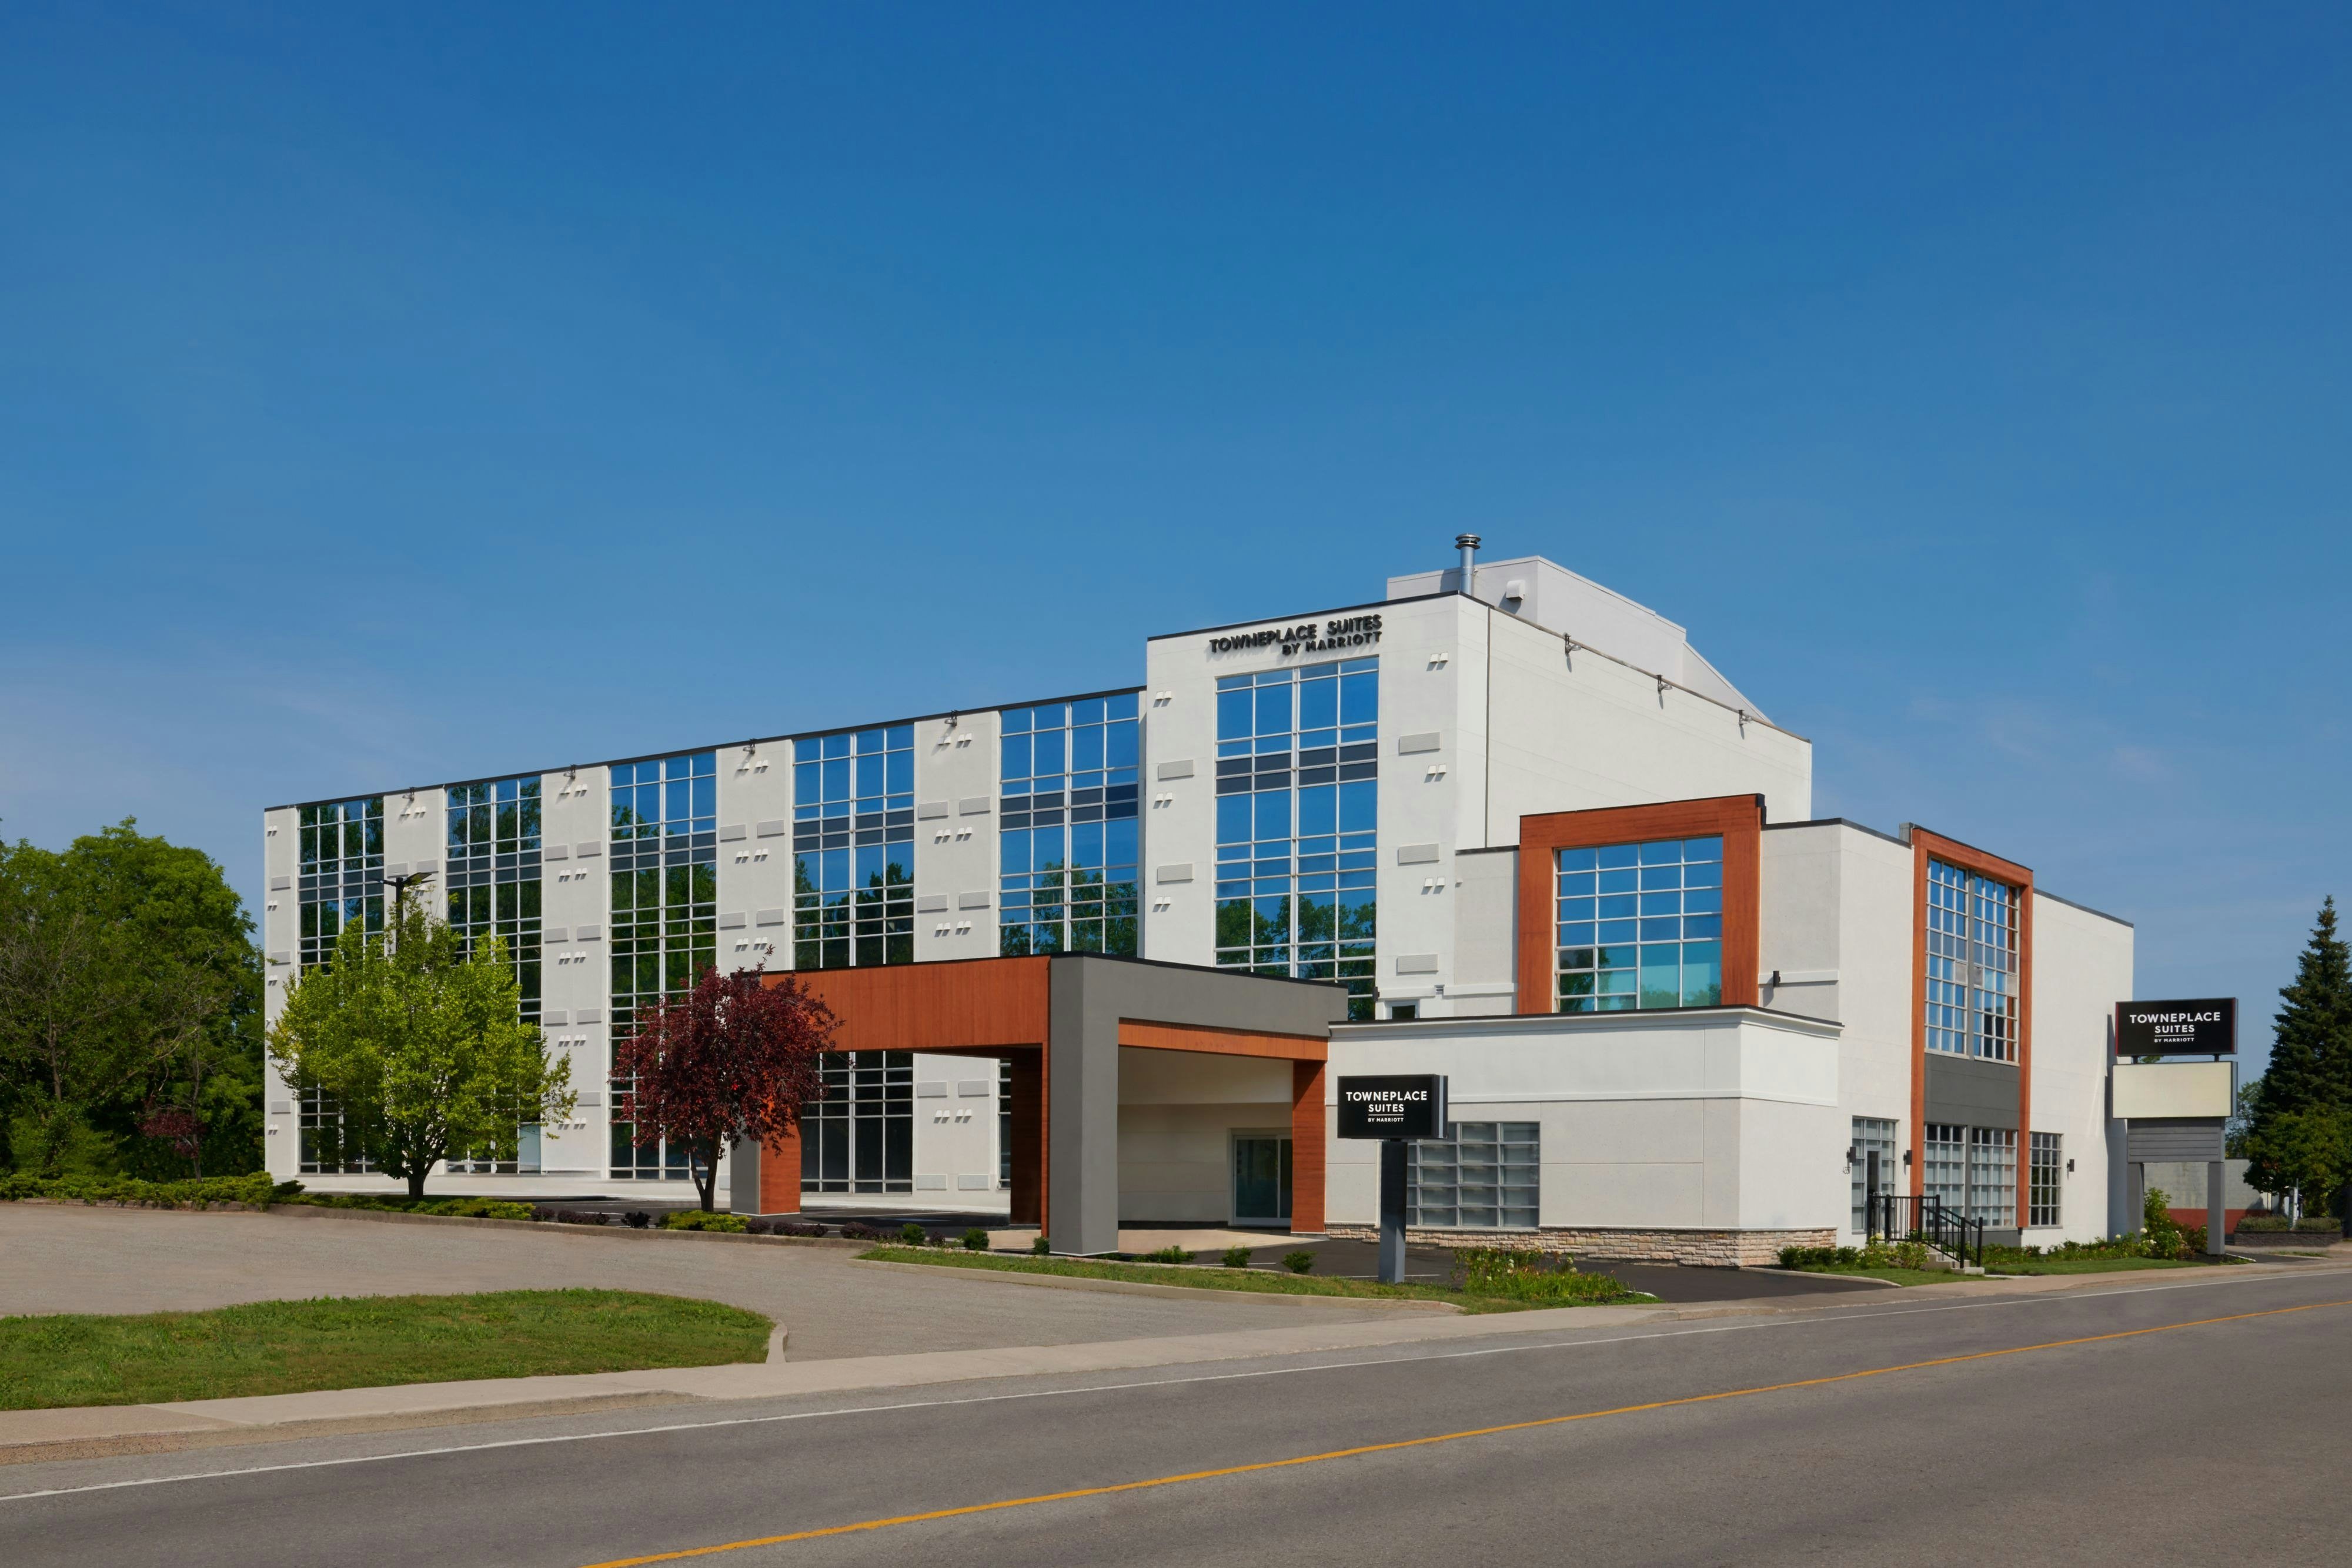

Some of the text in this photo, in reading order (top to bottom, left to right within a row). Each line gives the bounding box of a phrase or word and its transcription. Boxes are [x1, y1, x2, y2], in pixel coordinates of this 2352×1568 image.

[1210, 614, 1382, 653] TOWNEPLACE SUITES
[1282, 631, 1382, 656] BY MARRIOTT
[2129, 1012, 2220, 1024] TOWNEPLACE
[2154, 1025, 2194, 1033] SUITES
[1346, 1091, 1427, 1101] TOWNEPLACE
[1368, 1104, 1404, 1112] SUITES
